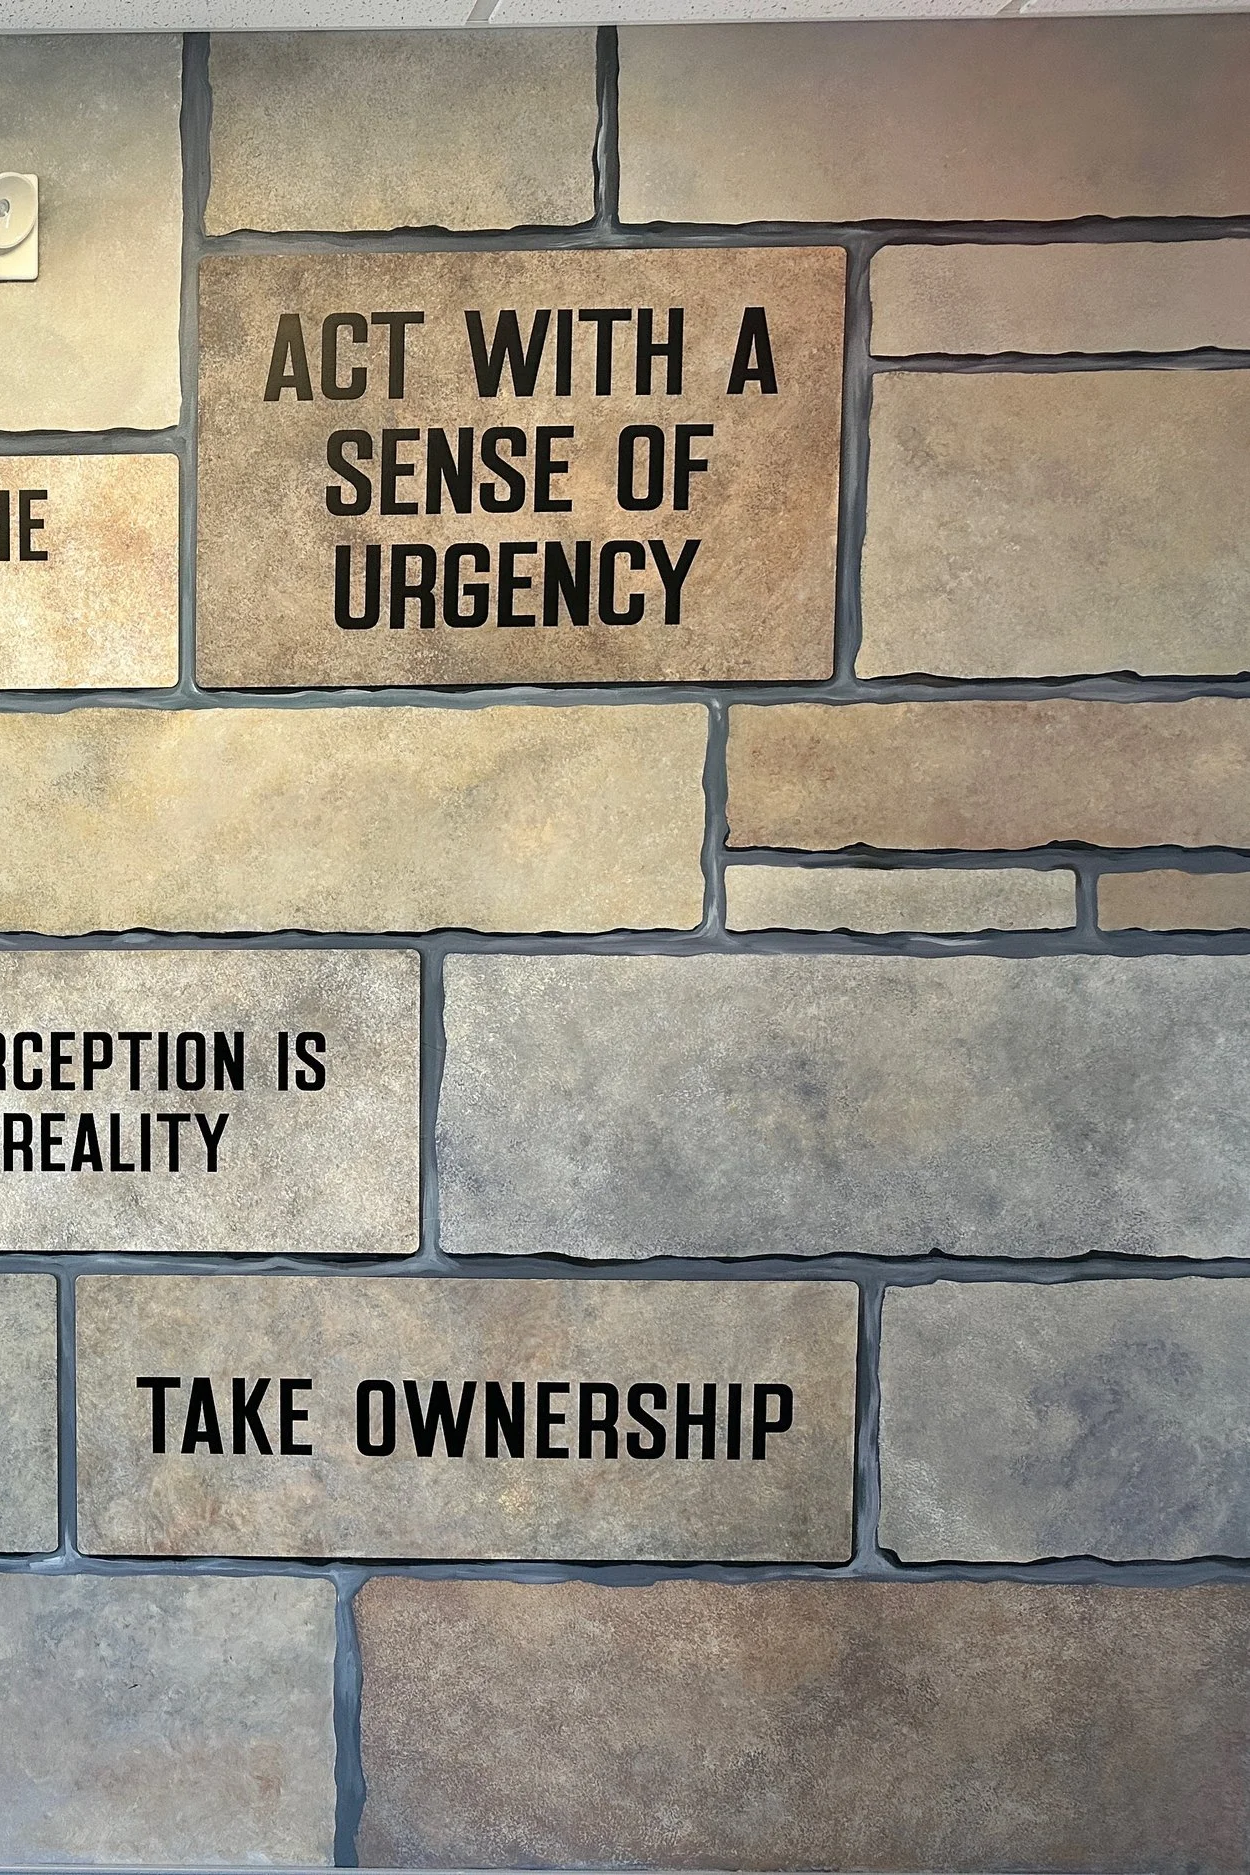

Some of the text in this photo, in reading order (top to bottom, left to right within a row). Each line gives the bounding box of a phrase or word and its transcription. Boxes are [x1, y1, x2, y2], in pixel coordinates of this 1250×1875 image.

[263, 307, 778, 401] ACT WITH A
[326, 424, 714, 516] SENSE OF
[335, 539, 702, 630] URGENCY
[278, 1032, 326, 1091] IS
[3, 1113, 229, 1172] REALITY
[137, 1377, 793, 1460] TAKE OWNERSHIP
